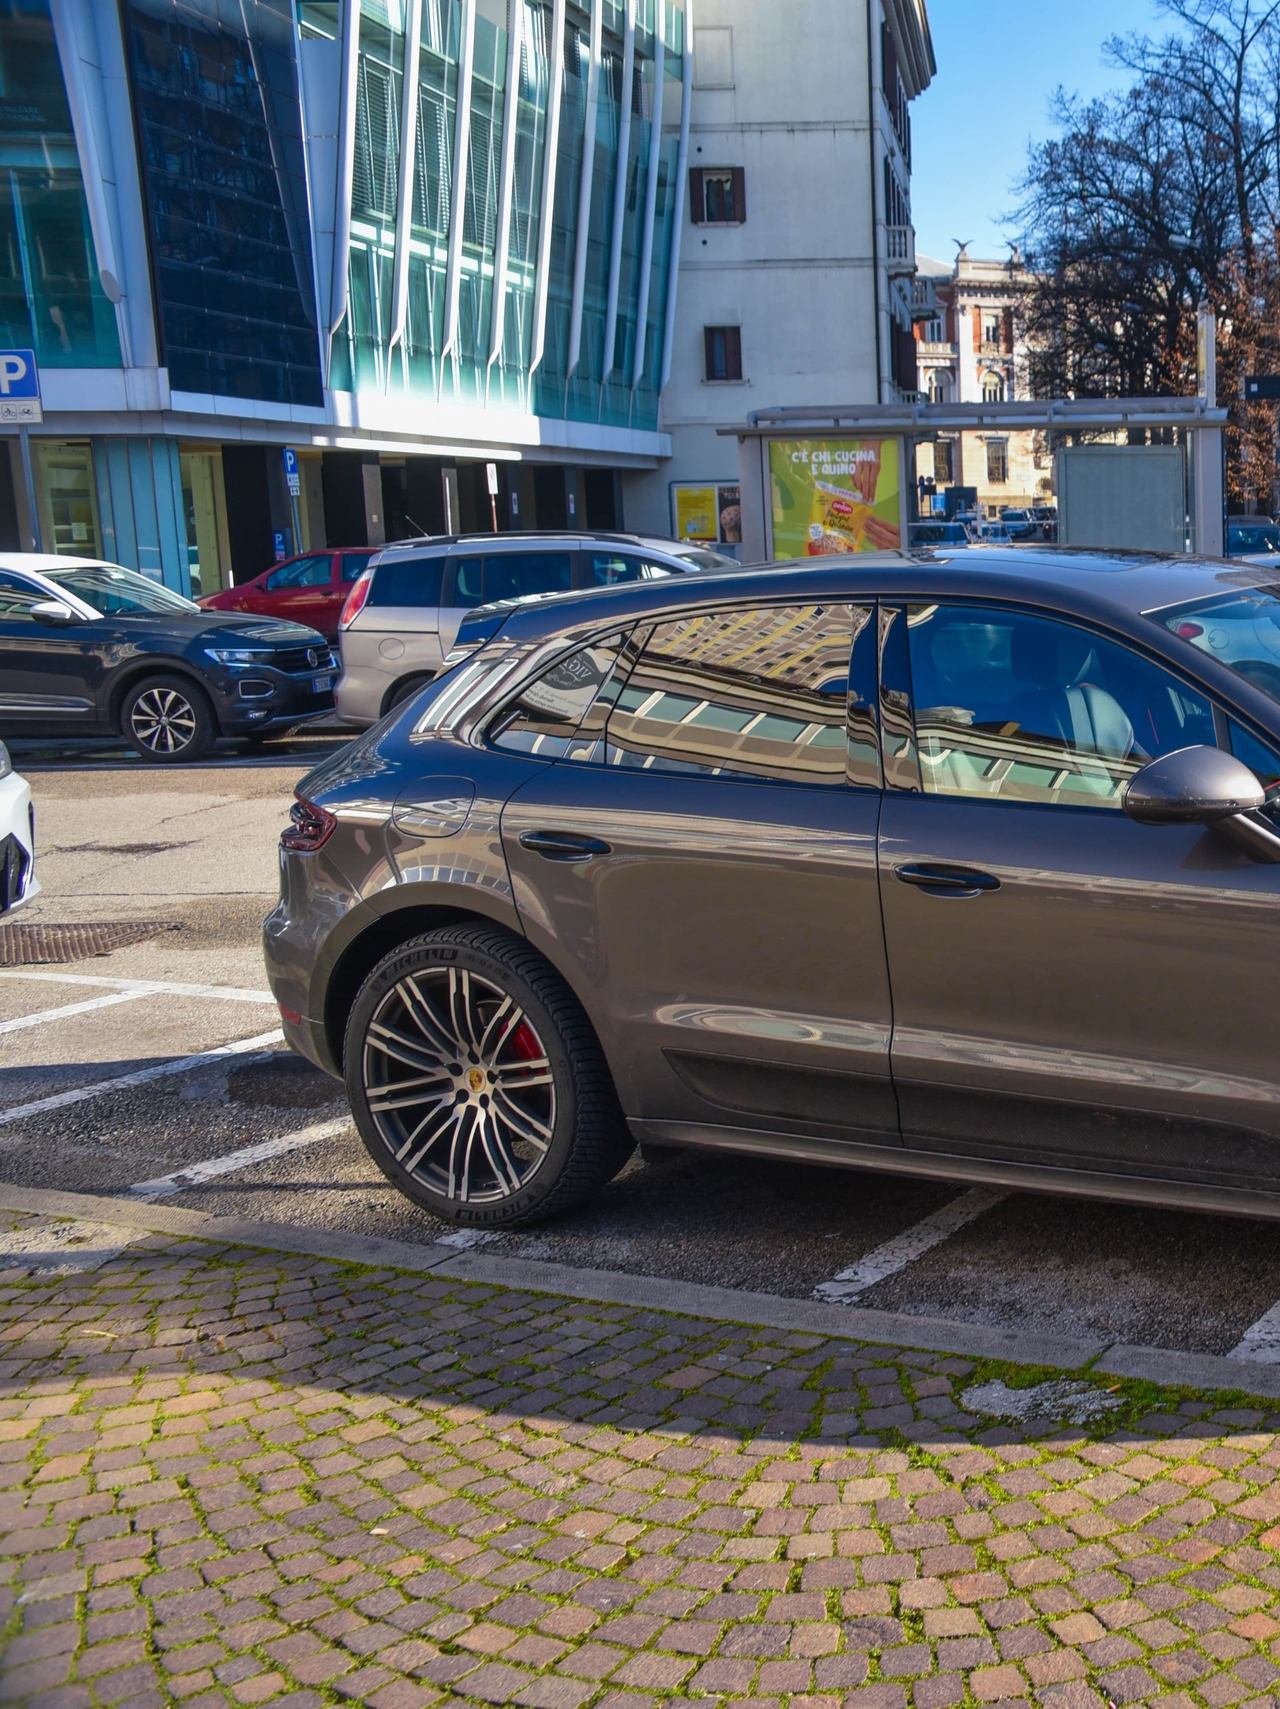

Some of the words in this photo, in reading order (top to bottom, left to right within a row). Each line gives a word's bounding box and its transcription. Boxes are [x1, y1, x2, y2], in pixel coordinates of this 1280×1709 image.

[0, 355, 26, 394] P
[286, 452, 294, 471] P
[791, 449, 808, 463] C'È
[812, 451, 831, 463] CHI
[835, 450, 876, 462] CUCINA
[811, 464, 818, 475] E
[822, 463, 856, 475] QUINO
[275, 533, 283, 545] P
[386, 949, 454, 978] MICHELIN
[459, 1194, 530, 1221] MICHELIN
